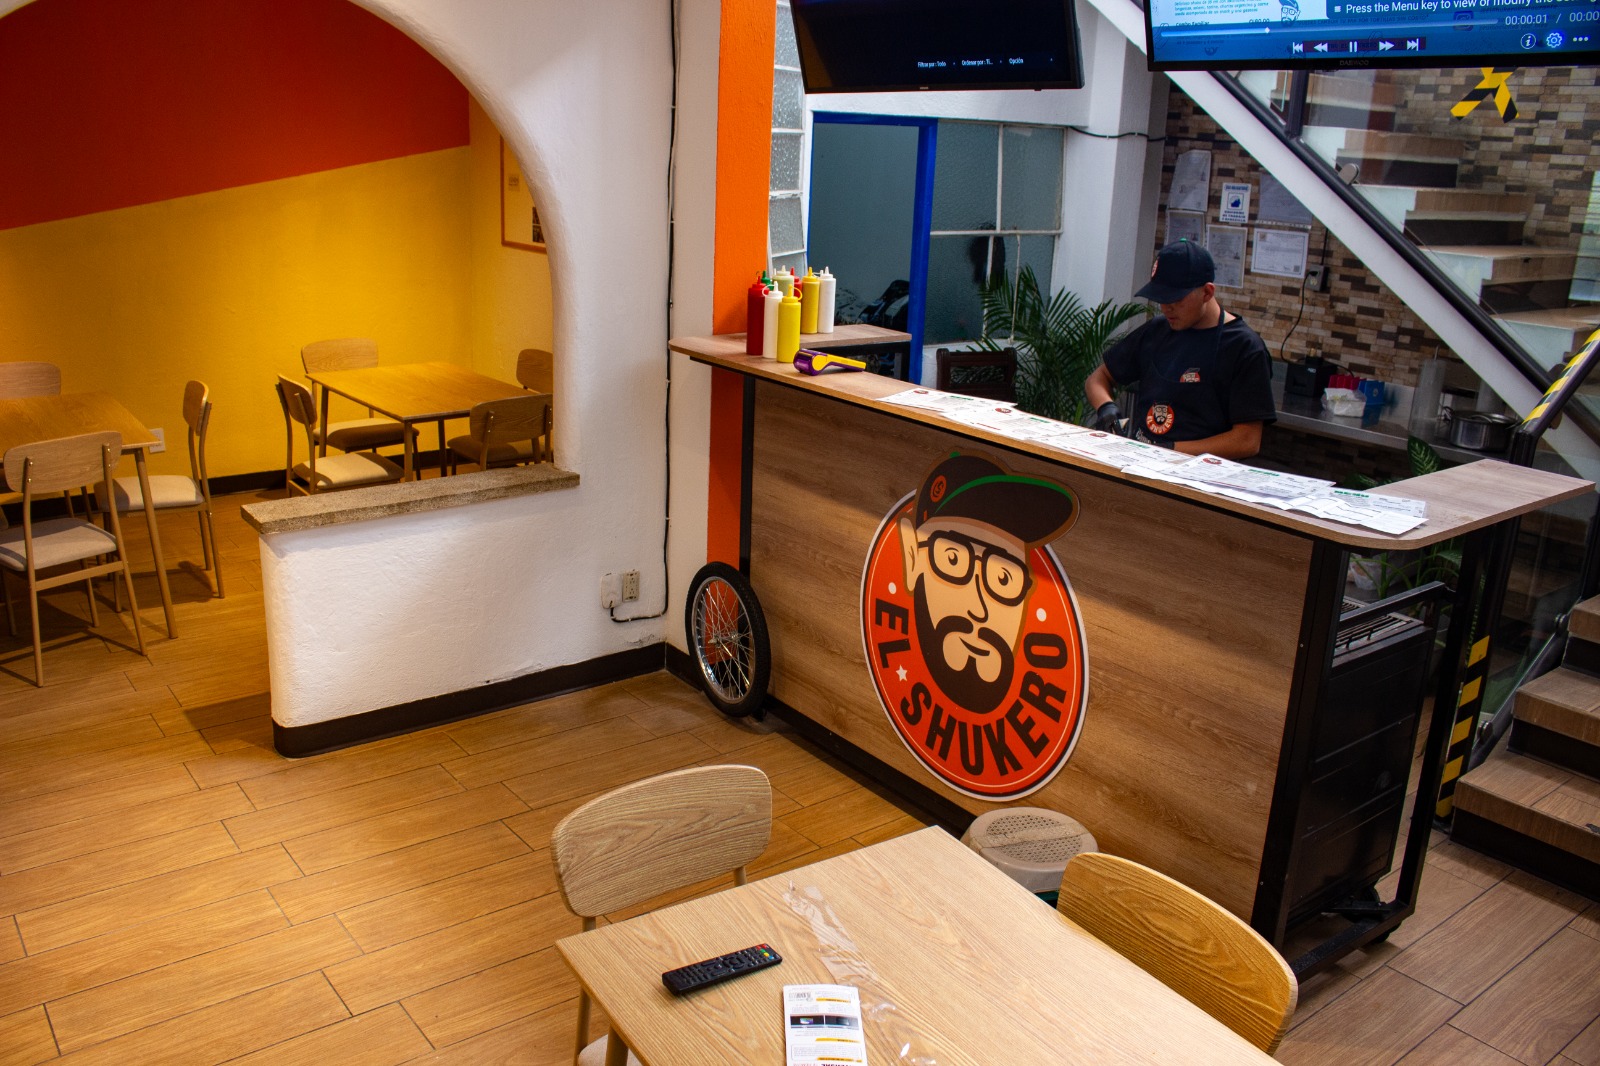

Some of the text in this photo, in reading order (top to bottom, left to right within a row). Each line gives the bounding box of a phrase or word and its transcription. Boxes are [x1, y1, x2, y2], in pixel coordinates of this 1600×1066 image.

[1346, 4, 1373, 14] Press
[1374, 2, 1390, 12] the
[1391, 1, 1419, 11] Menu
[1421, 0, 1439, 12] key
[1440, 0, 1451, 9] to
[1453, 0, 1477, 8] view
[1505, 14, 1548, 25] 00:00:01
[874, 597, 1069, 777] EL SHUKERO
